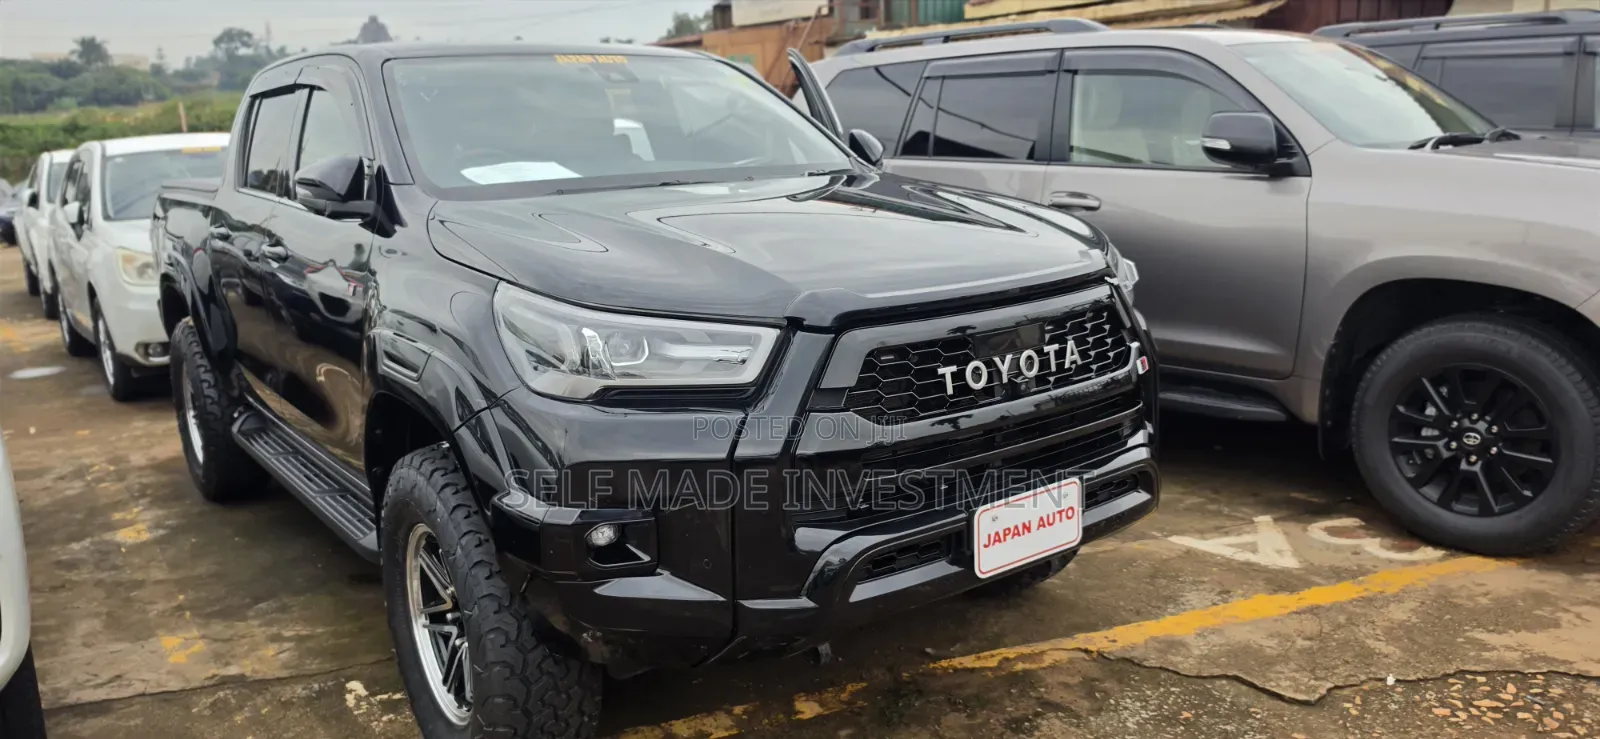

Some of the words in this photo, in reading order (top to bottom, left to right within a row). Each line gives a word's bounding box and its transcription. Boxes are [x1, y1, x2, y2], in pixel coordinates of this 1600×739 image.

[555, 54, 594, 64] JAPAN
[596, 54, 628, 64] AUTO
[937, 339, 1082, 396] TOYOTA
[983, 520, 1032, 549] JAPAN
[1036, 506, 1075, 531] AUTO
